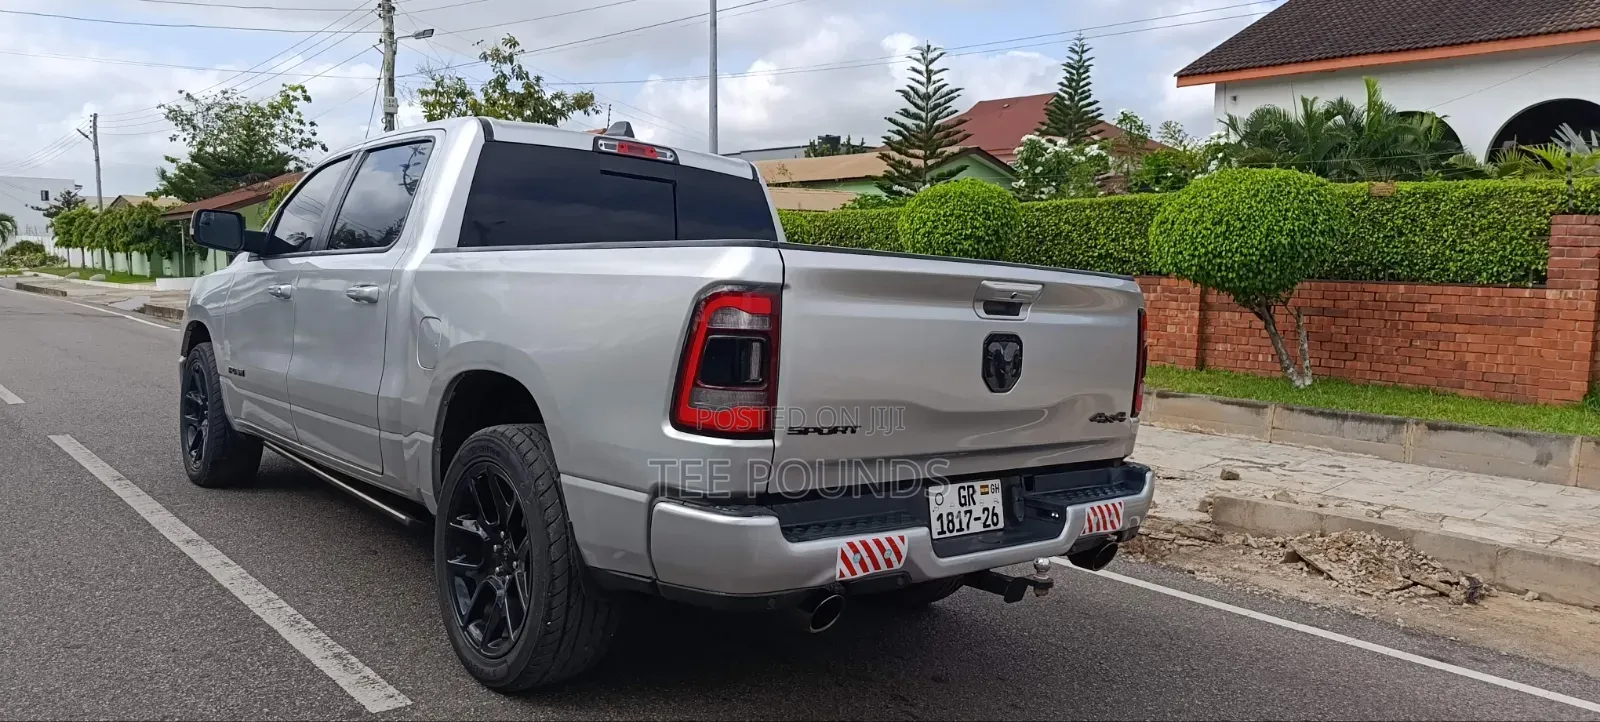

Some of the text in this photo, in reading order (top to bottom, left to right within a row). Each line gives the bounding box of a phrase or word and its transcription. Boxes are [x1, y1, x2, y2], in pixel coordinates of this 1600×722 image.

[787, 425, 861, 436] SPORT
[957, 484, 977, 507] GR
[990, 483, 1000, 494] GH
[936, 505, 999, 536] 1817-26
